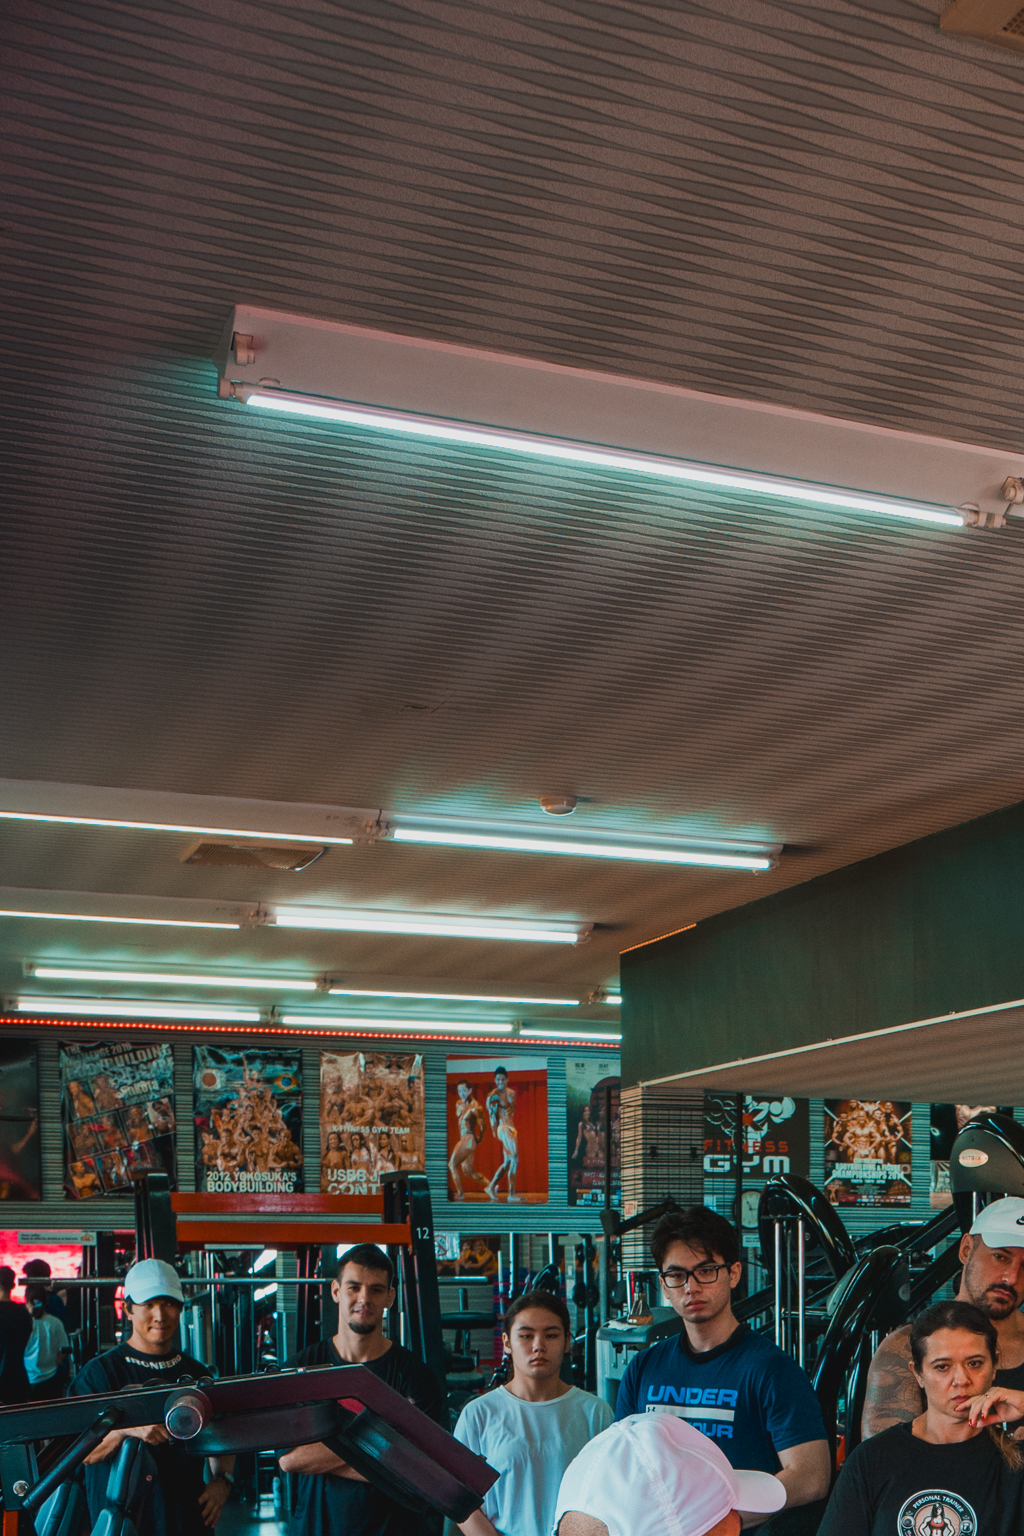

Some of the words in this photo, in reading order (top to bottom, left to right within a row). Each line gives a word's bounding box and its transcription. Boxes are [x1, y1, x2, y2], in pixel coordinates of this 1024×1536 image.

[372, 1125, 388, 1134] GYM
[390, 1126, 410, 1135] TEAM
[703, 1154, 790, 1174] GYM
[206, 1171, 231, 1182] 2012
[234, 1171, 297, 1182] YOKOSUKA'S
[206, 1181, 294, 1193] BODYBUILDING
[416, 1226, 430, 1239] 12
[647, 1385, 739, 1407] UNDER
[912, 1495, 941, 1509] PERSONAL
[942, 1495, 964, 1513] TRAINER
